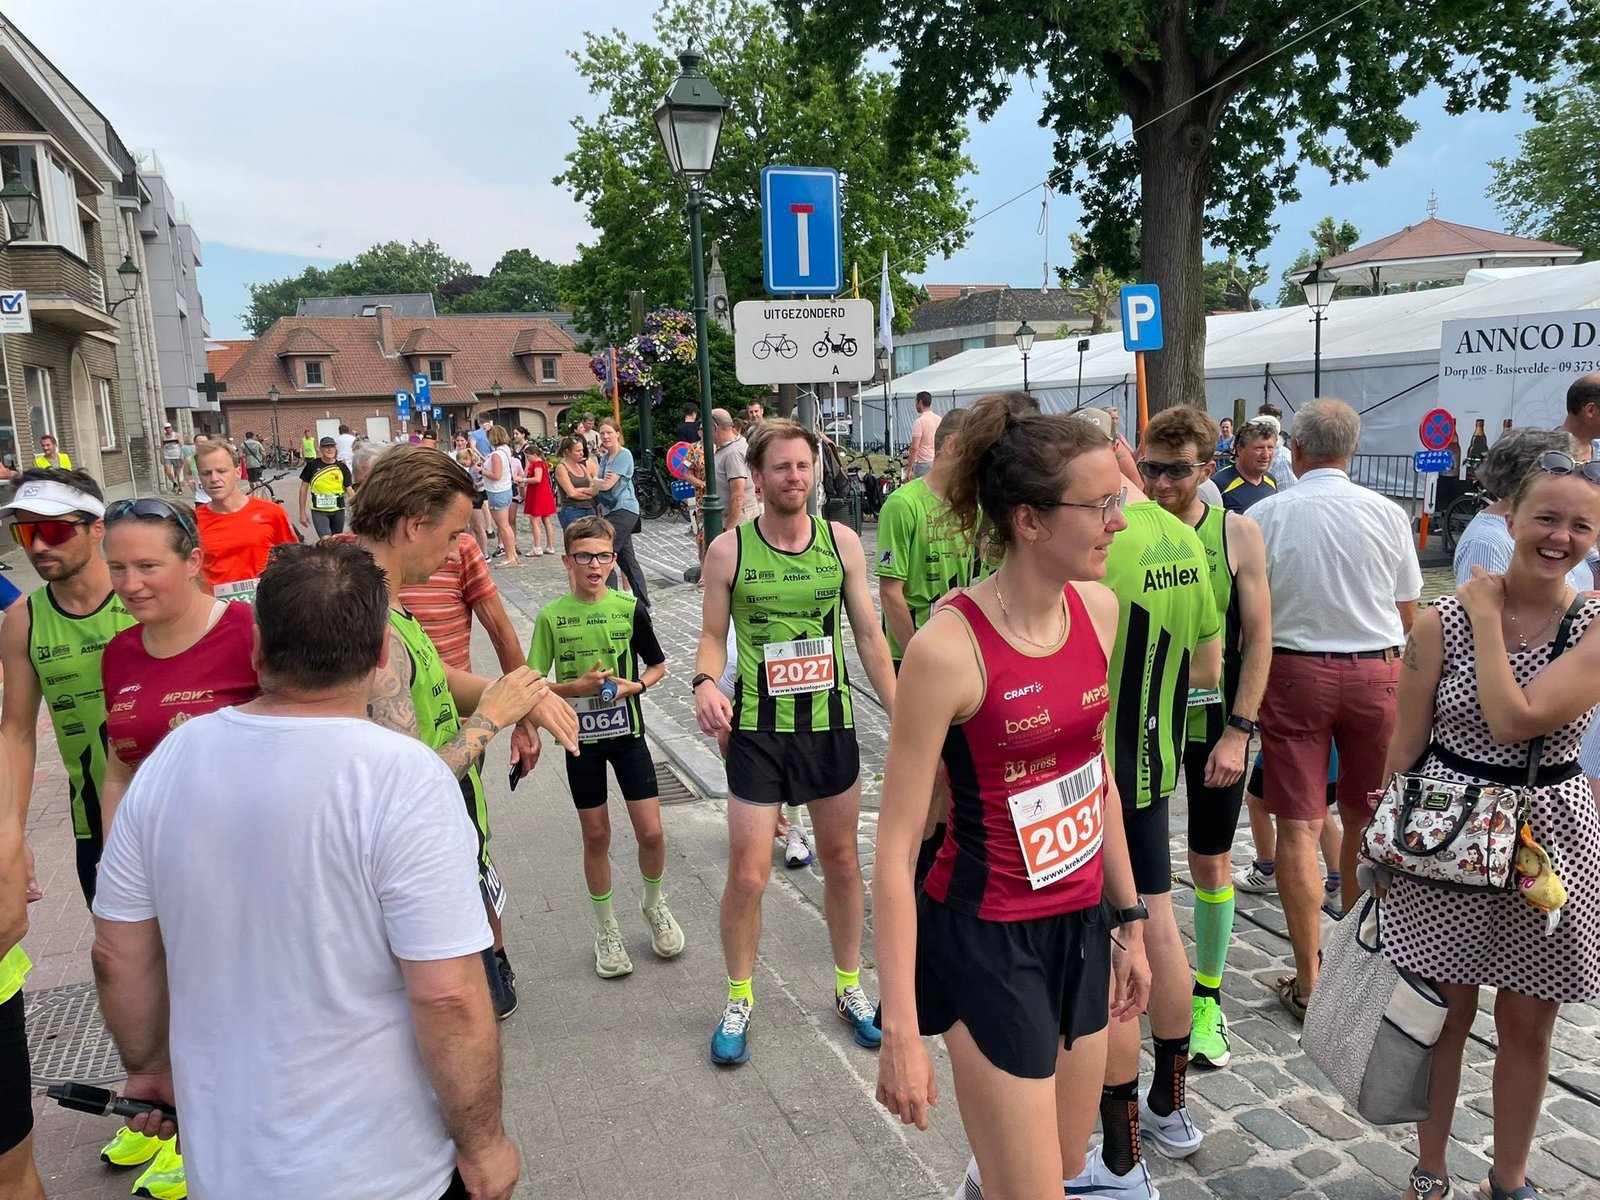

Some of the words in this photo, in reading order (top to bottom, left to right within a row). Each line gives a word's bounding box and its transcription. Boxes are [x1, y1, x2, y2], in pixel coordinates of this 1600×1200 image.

[764, 307, 845, 320] UITGEZONDERD
[1127, 295, 1156, 341] P
[1455, 324, 1564, 354] ANNCO
[1571, 321, 1600, 348] D
[832, 365, 840, 375] A
[1444, 366, 1468, 379] Dorp
[1471, 365, 1487, 375] 108
[1496, 363, 1549, 375] Bassevelde
[1559, 361, 1572, 372] 09
[1574, 361, 1593, 372] 373
[415, 378, 427, 393] P
[397, 394, 407, 406] P
[433, 409, 441, 418] P
[783, 574, 811, 582] Athlex
[1142, 565, 1200, 594] Athlex
[771, 658, 830, 684] 2027
[1004, 684, 1035, 700] CRAFT
[578, 710, 625, 731] 064
[1030, 757, 1057, 774] press
[1030, 793, 1101, 867] 2031
